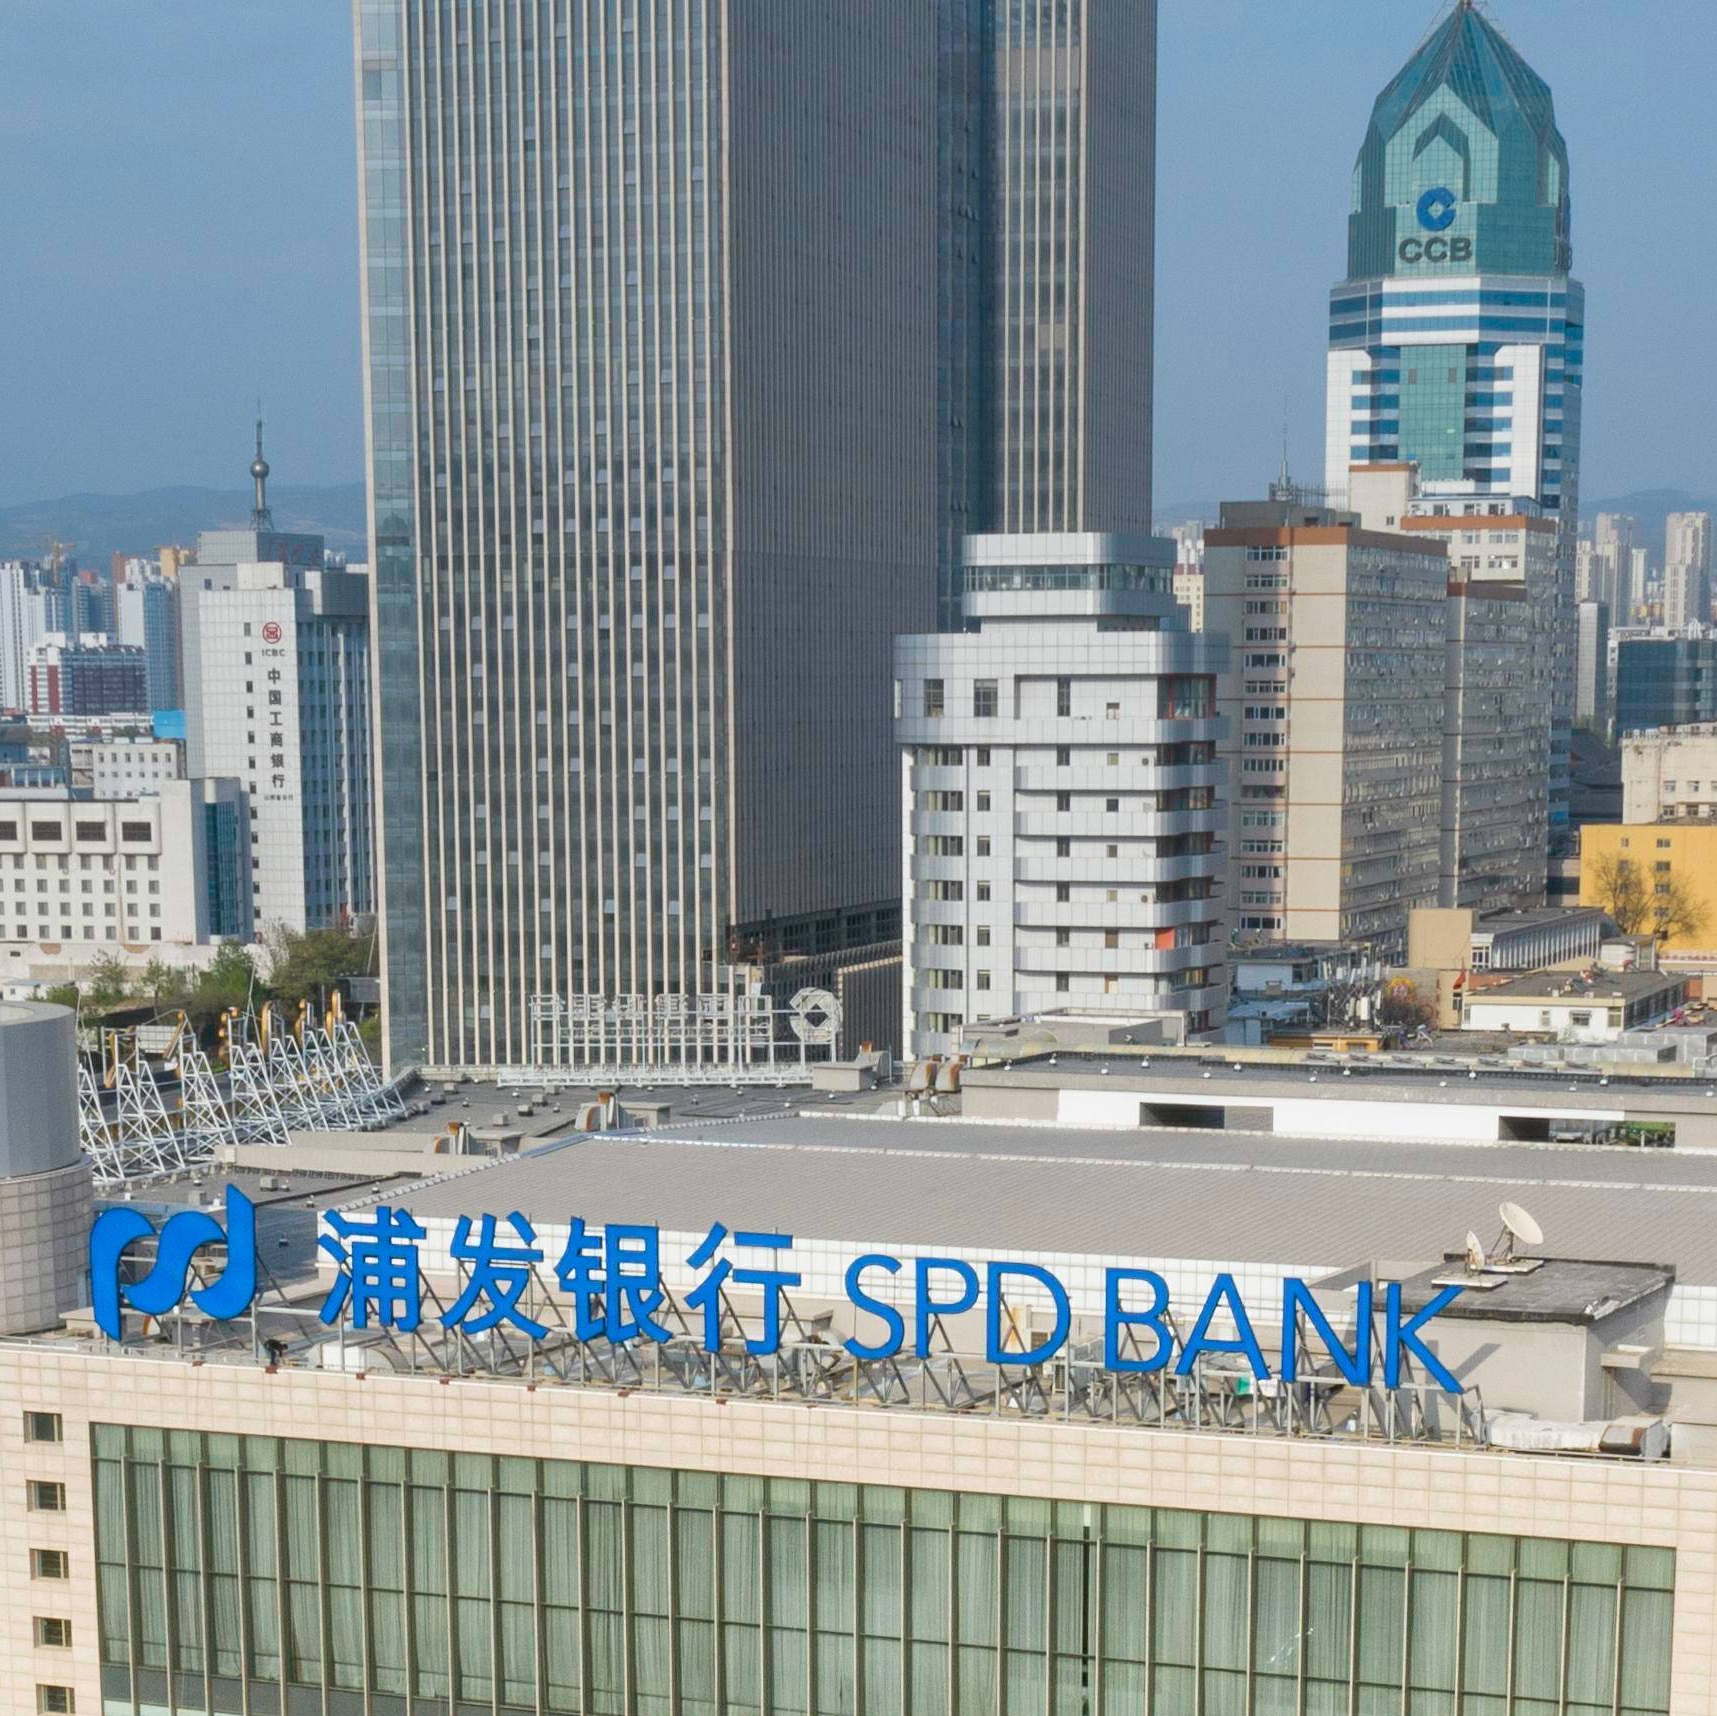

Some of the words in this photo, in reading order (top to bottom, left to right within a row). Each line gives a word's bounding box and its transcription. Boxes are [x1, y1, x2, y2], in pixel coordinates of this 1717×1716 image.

[1398, 237, 1473, 263] CCB
[261, 649, 286, 657] ICBC
[267, 667, 285, 789] 中国工商银行
[316, 1206, 802, 1355] 浦发银行
[843, 1254, 1071, 1364] SPD
[1105, 1267, 1464, 1394] BANK
